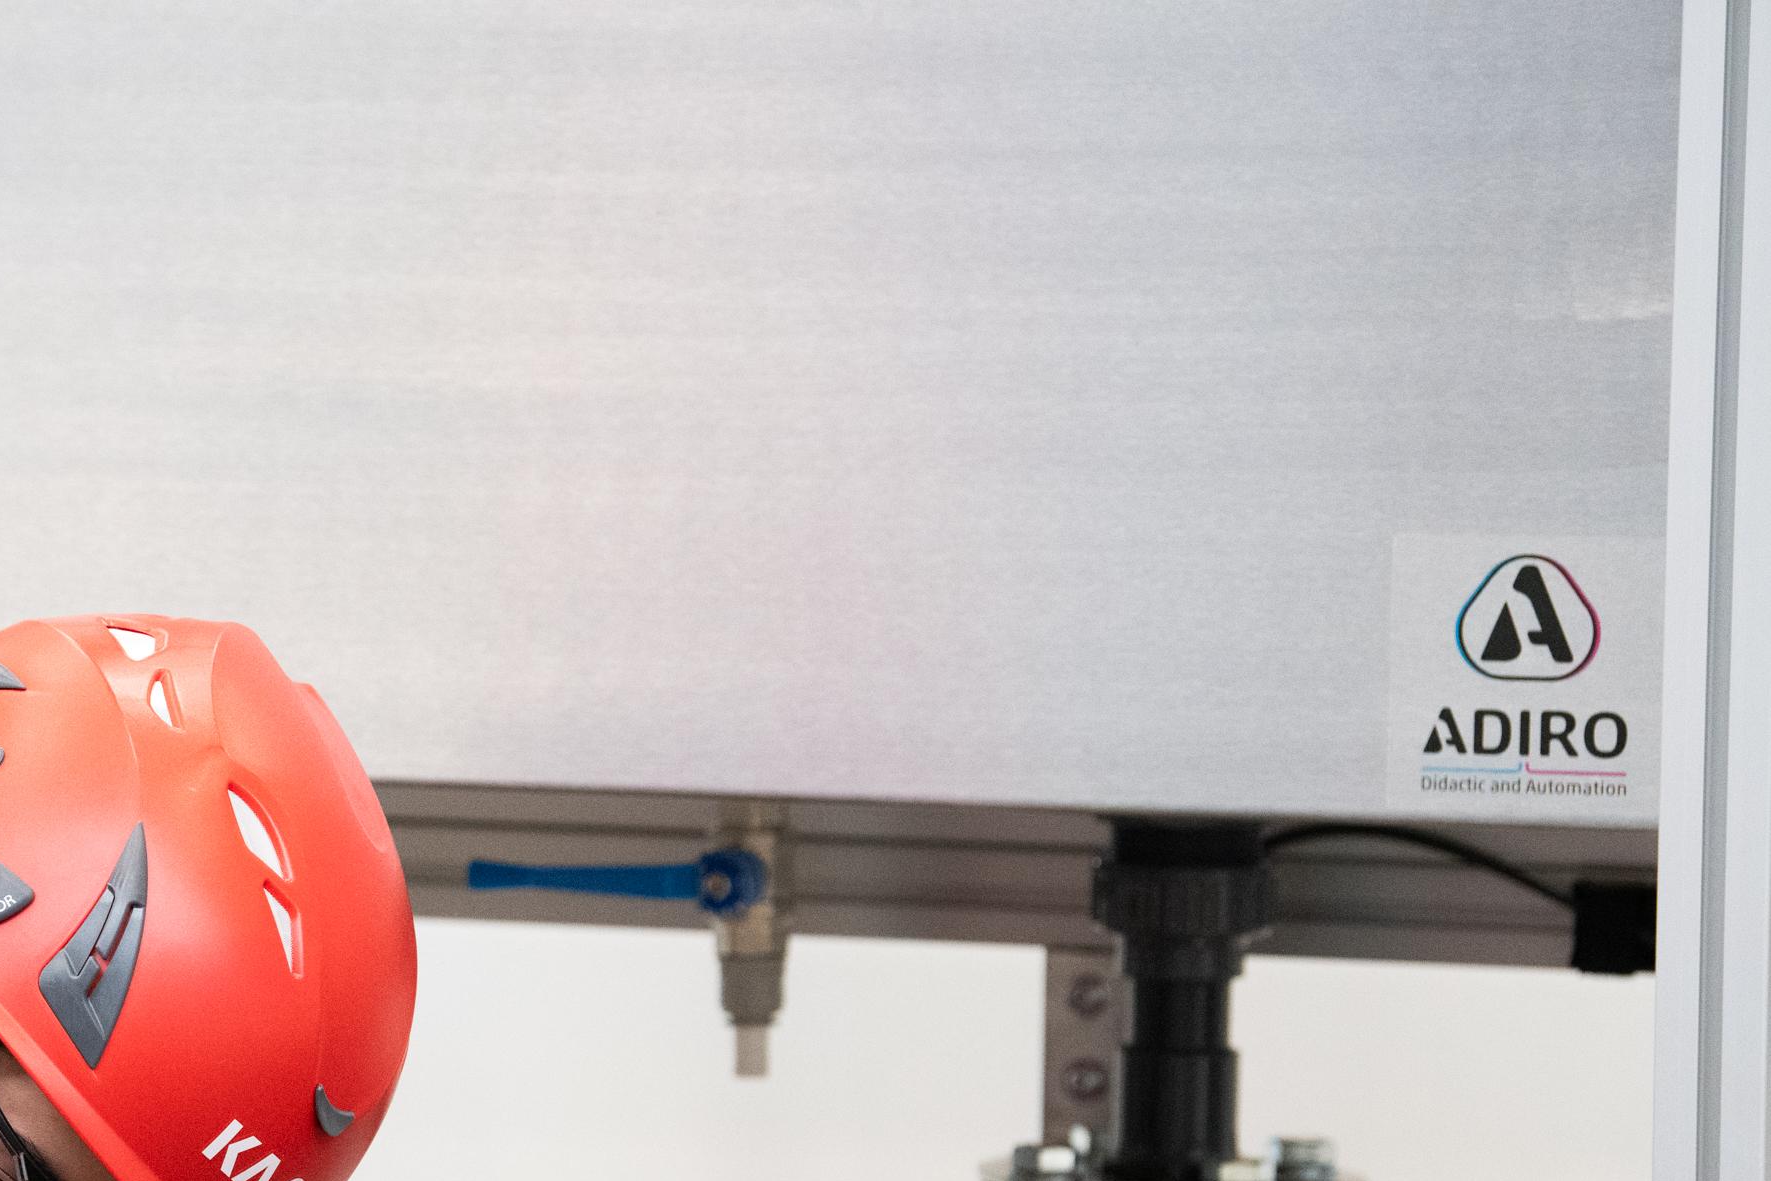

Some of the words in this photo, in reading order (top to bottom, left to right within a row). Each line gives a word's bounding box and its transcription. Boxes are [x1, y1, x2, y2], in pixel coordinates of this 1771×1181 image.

[1423, 707, 1628, 759] ADIRO
[1421, 776, 1486, 793] Didactic
[1491, 779, 1522, 794] and
[1525, 779, 1628, 796] Automation
